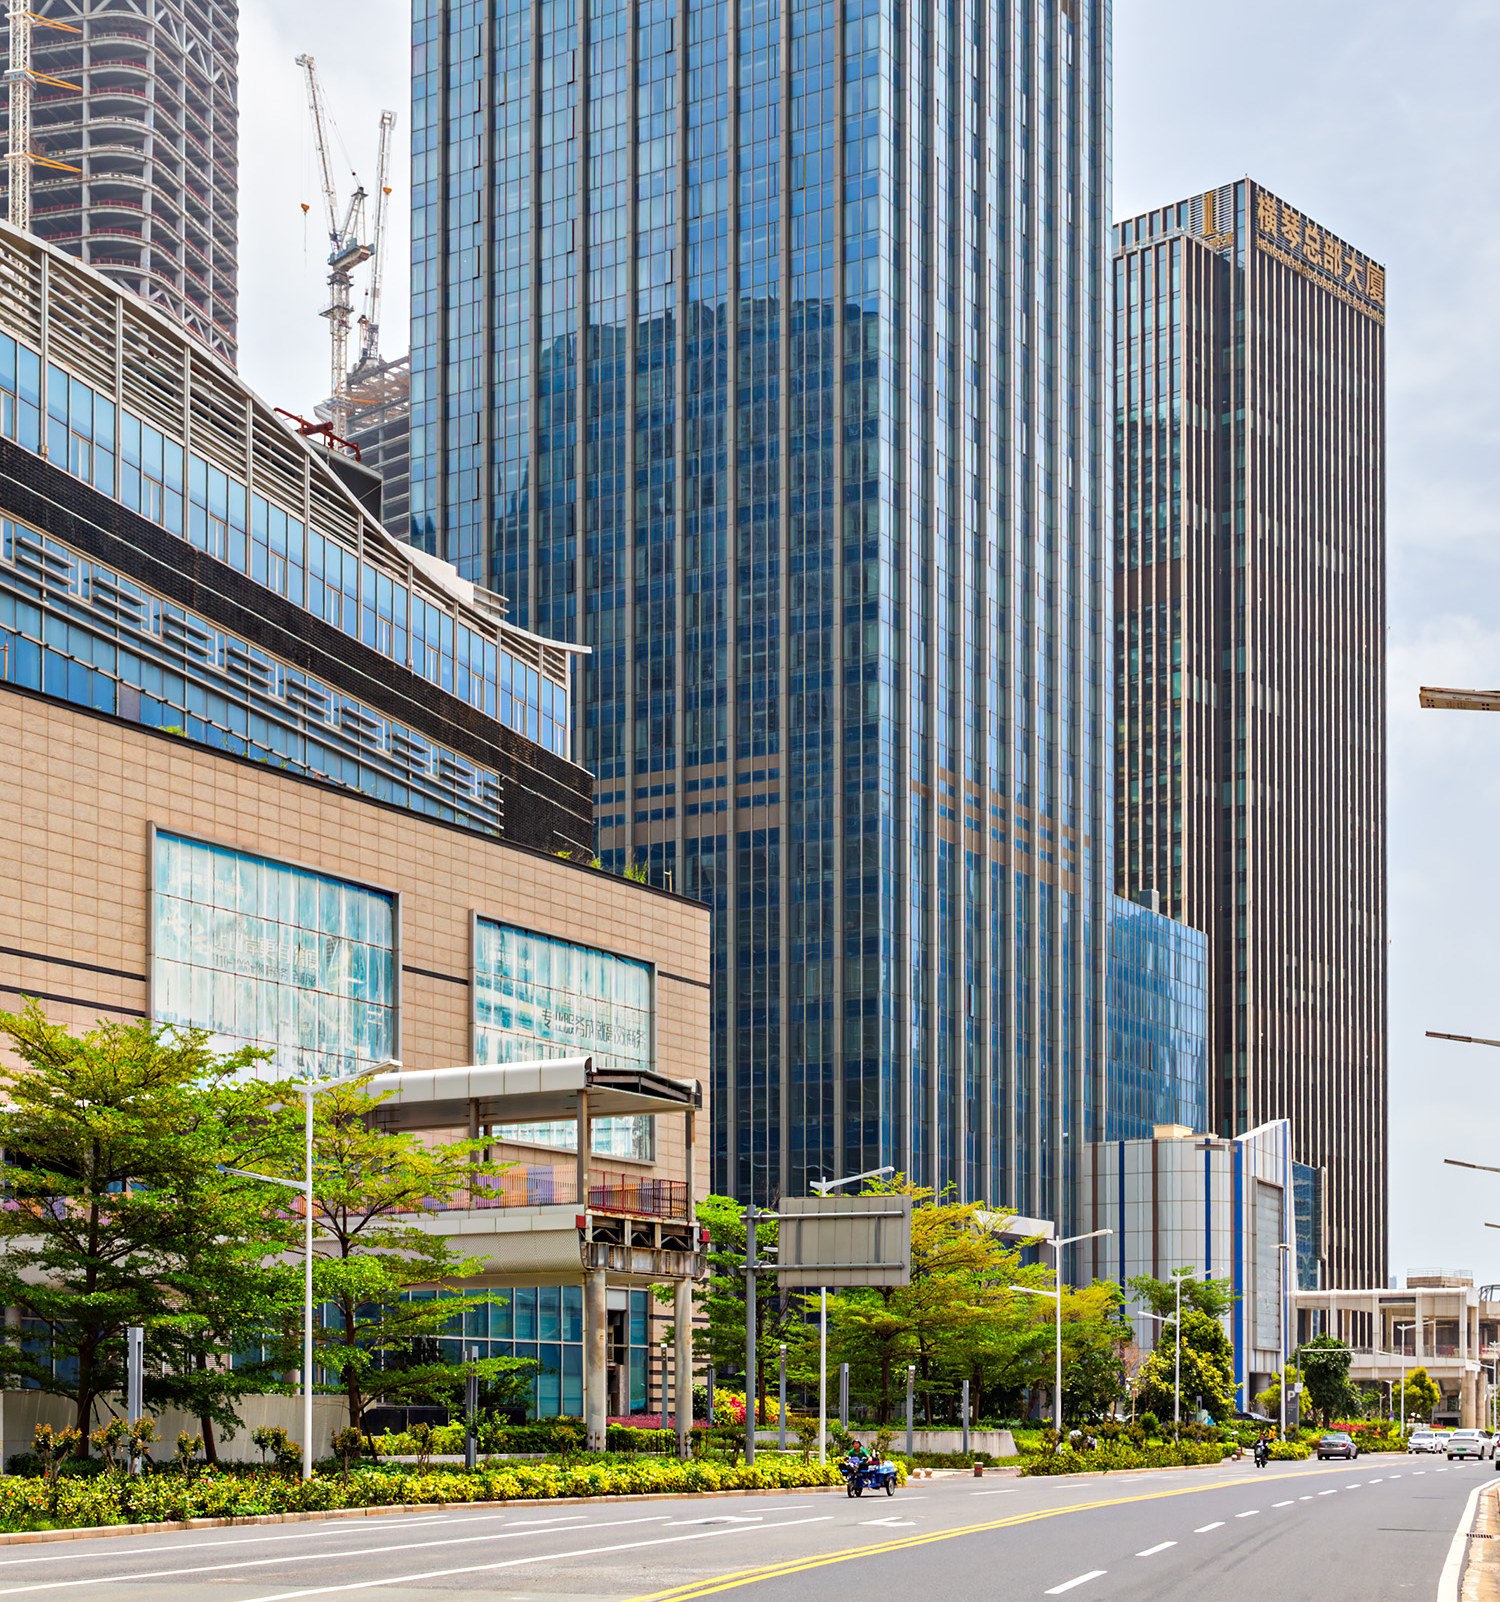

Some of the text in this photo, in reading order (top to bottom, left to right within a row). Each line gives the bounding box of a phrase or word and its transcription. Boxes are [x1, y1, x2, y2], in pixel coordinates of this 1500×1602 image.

[1257, 191, 1384, 307] 横琴总部大厦
[1288, 1390, 1296, 1401] P
